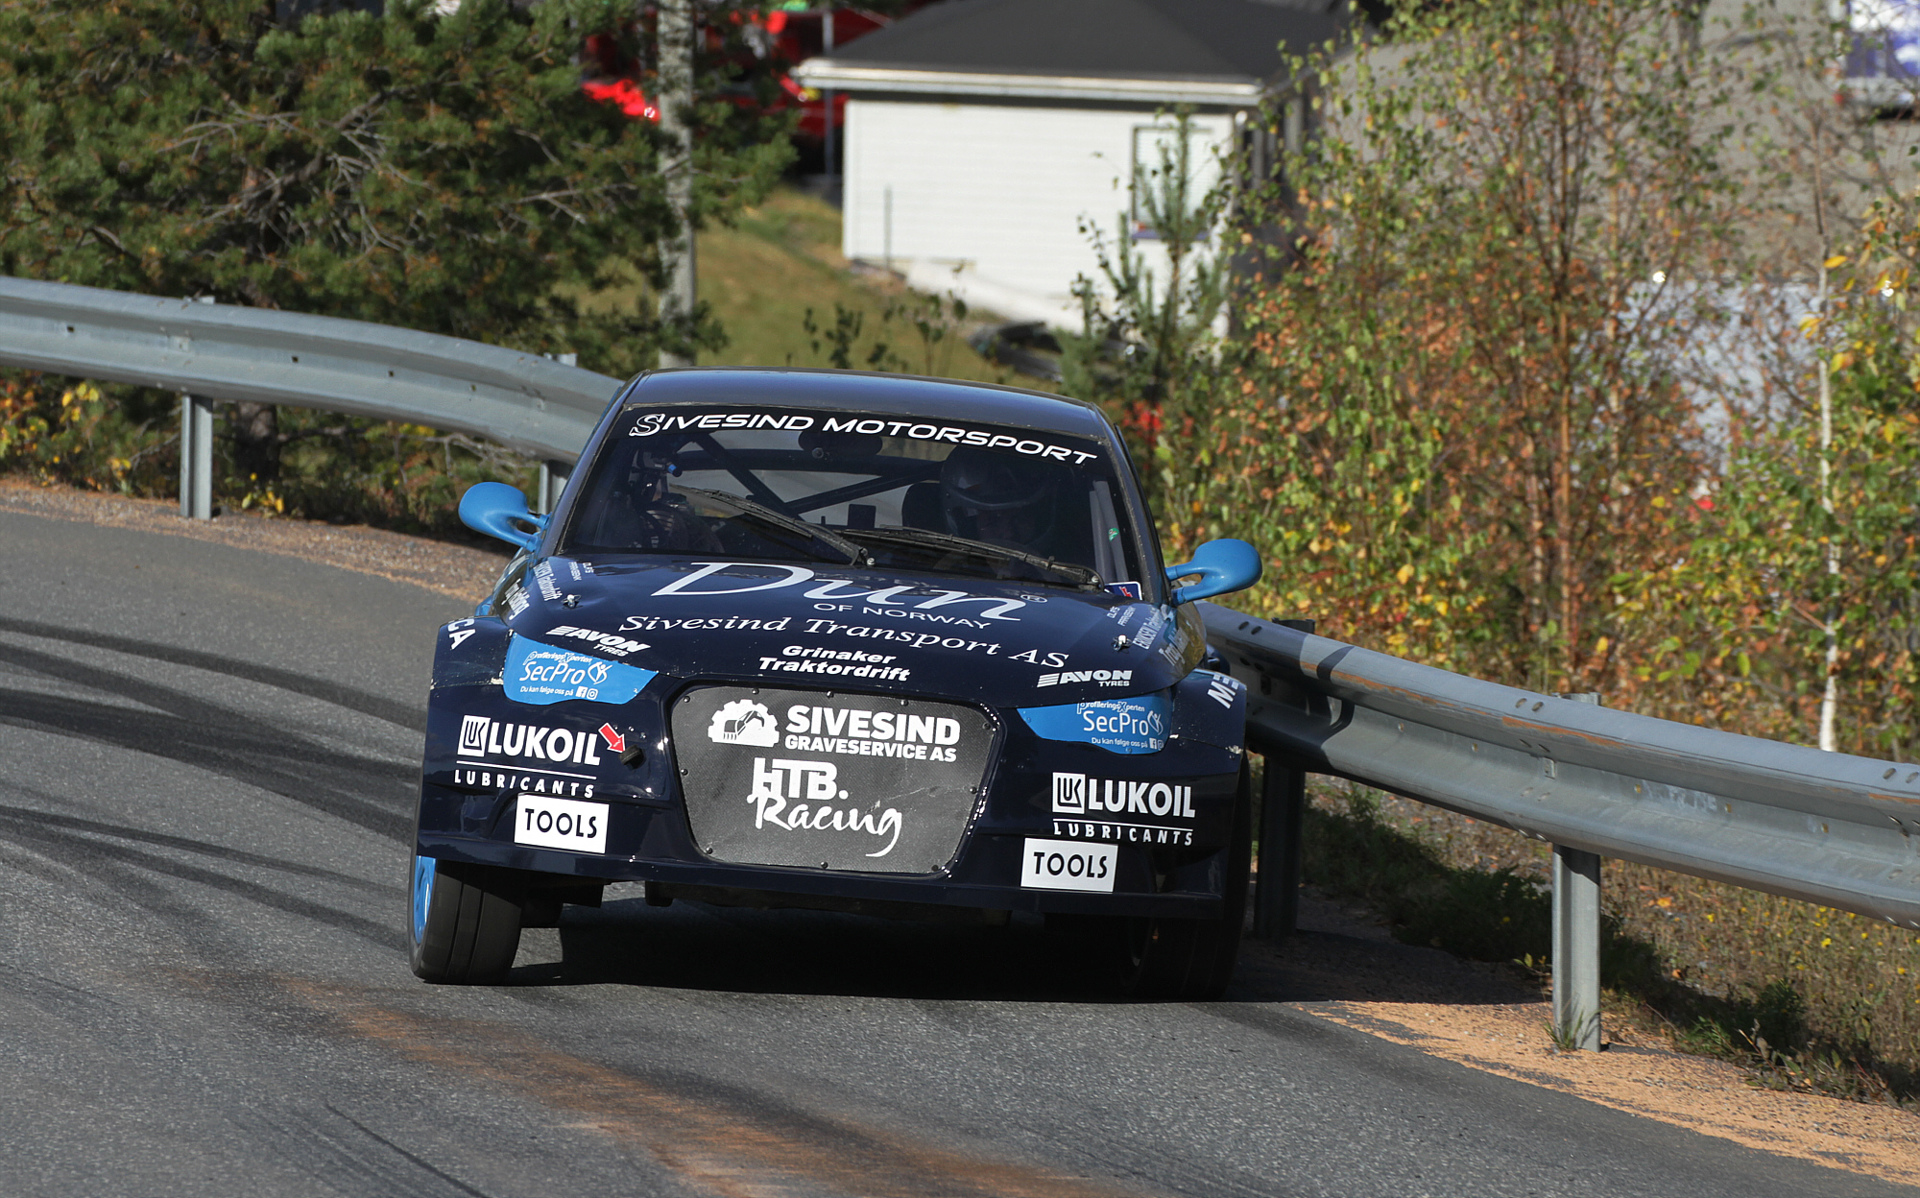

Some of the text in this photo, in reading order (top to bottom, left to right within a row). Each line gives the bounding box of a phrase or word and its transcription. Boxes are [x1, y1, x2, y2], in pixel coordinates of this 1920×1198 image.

[629, 413, 1097, 466] SIVESIND MOTORSPORT
[651, 562, 1021, 622] Dun
[813, 603, 991, 629] OF NORWAY
[568, 626, 651, 652] AVON
[594, 643, 628, 657] TYRES
[618, 615, 1069, 668] Sivesind Transport AS
[782, 645, 896, 665] Grinaker
[519, 661, 586, 684] SecPro
[759, 657, 910, 682] Traktordrift
[1059, 670, 1132, 685] AVON
[785, 705, 960, 745] SIVESIND
[1083, 710, 1149, 736] SecPro
[488, 722, 600, 766] LUKOIL
[785, 735, 957, 762] GRAVESERVICE AS
[1115, 738, 1129, 747] følge
[455, 769, 594, 798] LUBRICANTS
[752, 757, 848, 800] HTB.
[1088, 778, 1196, 818] LUKOIL
[525, 808, 597, 838] TOOLS
[747, 792, 902, 857] Racing
[1054, 822, 1193, 846] LUBRICANTS
[1033, 851, 1108, 878] TOOLS
